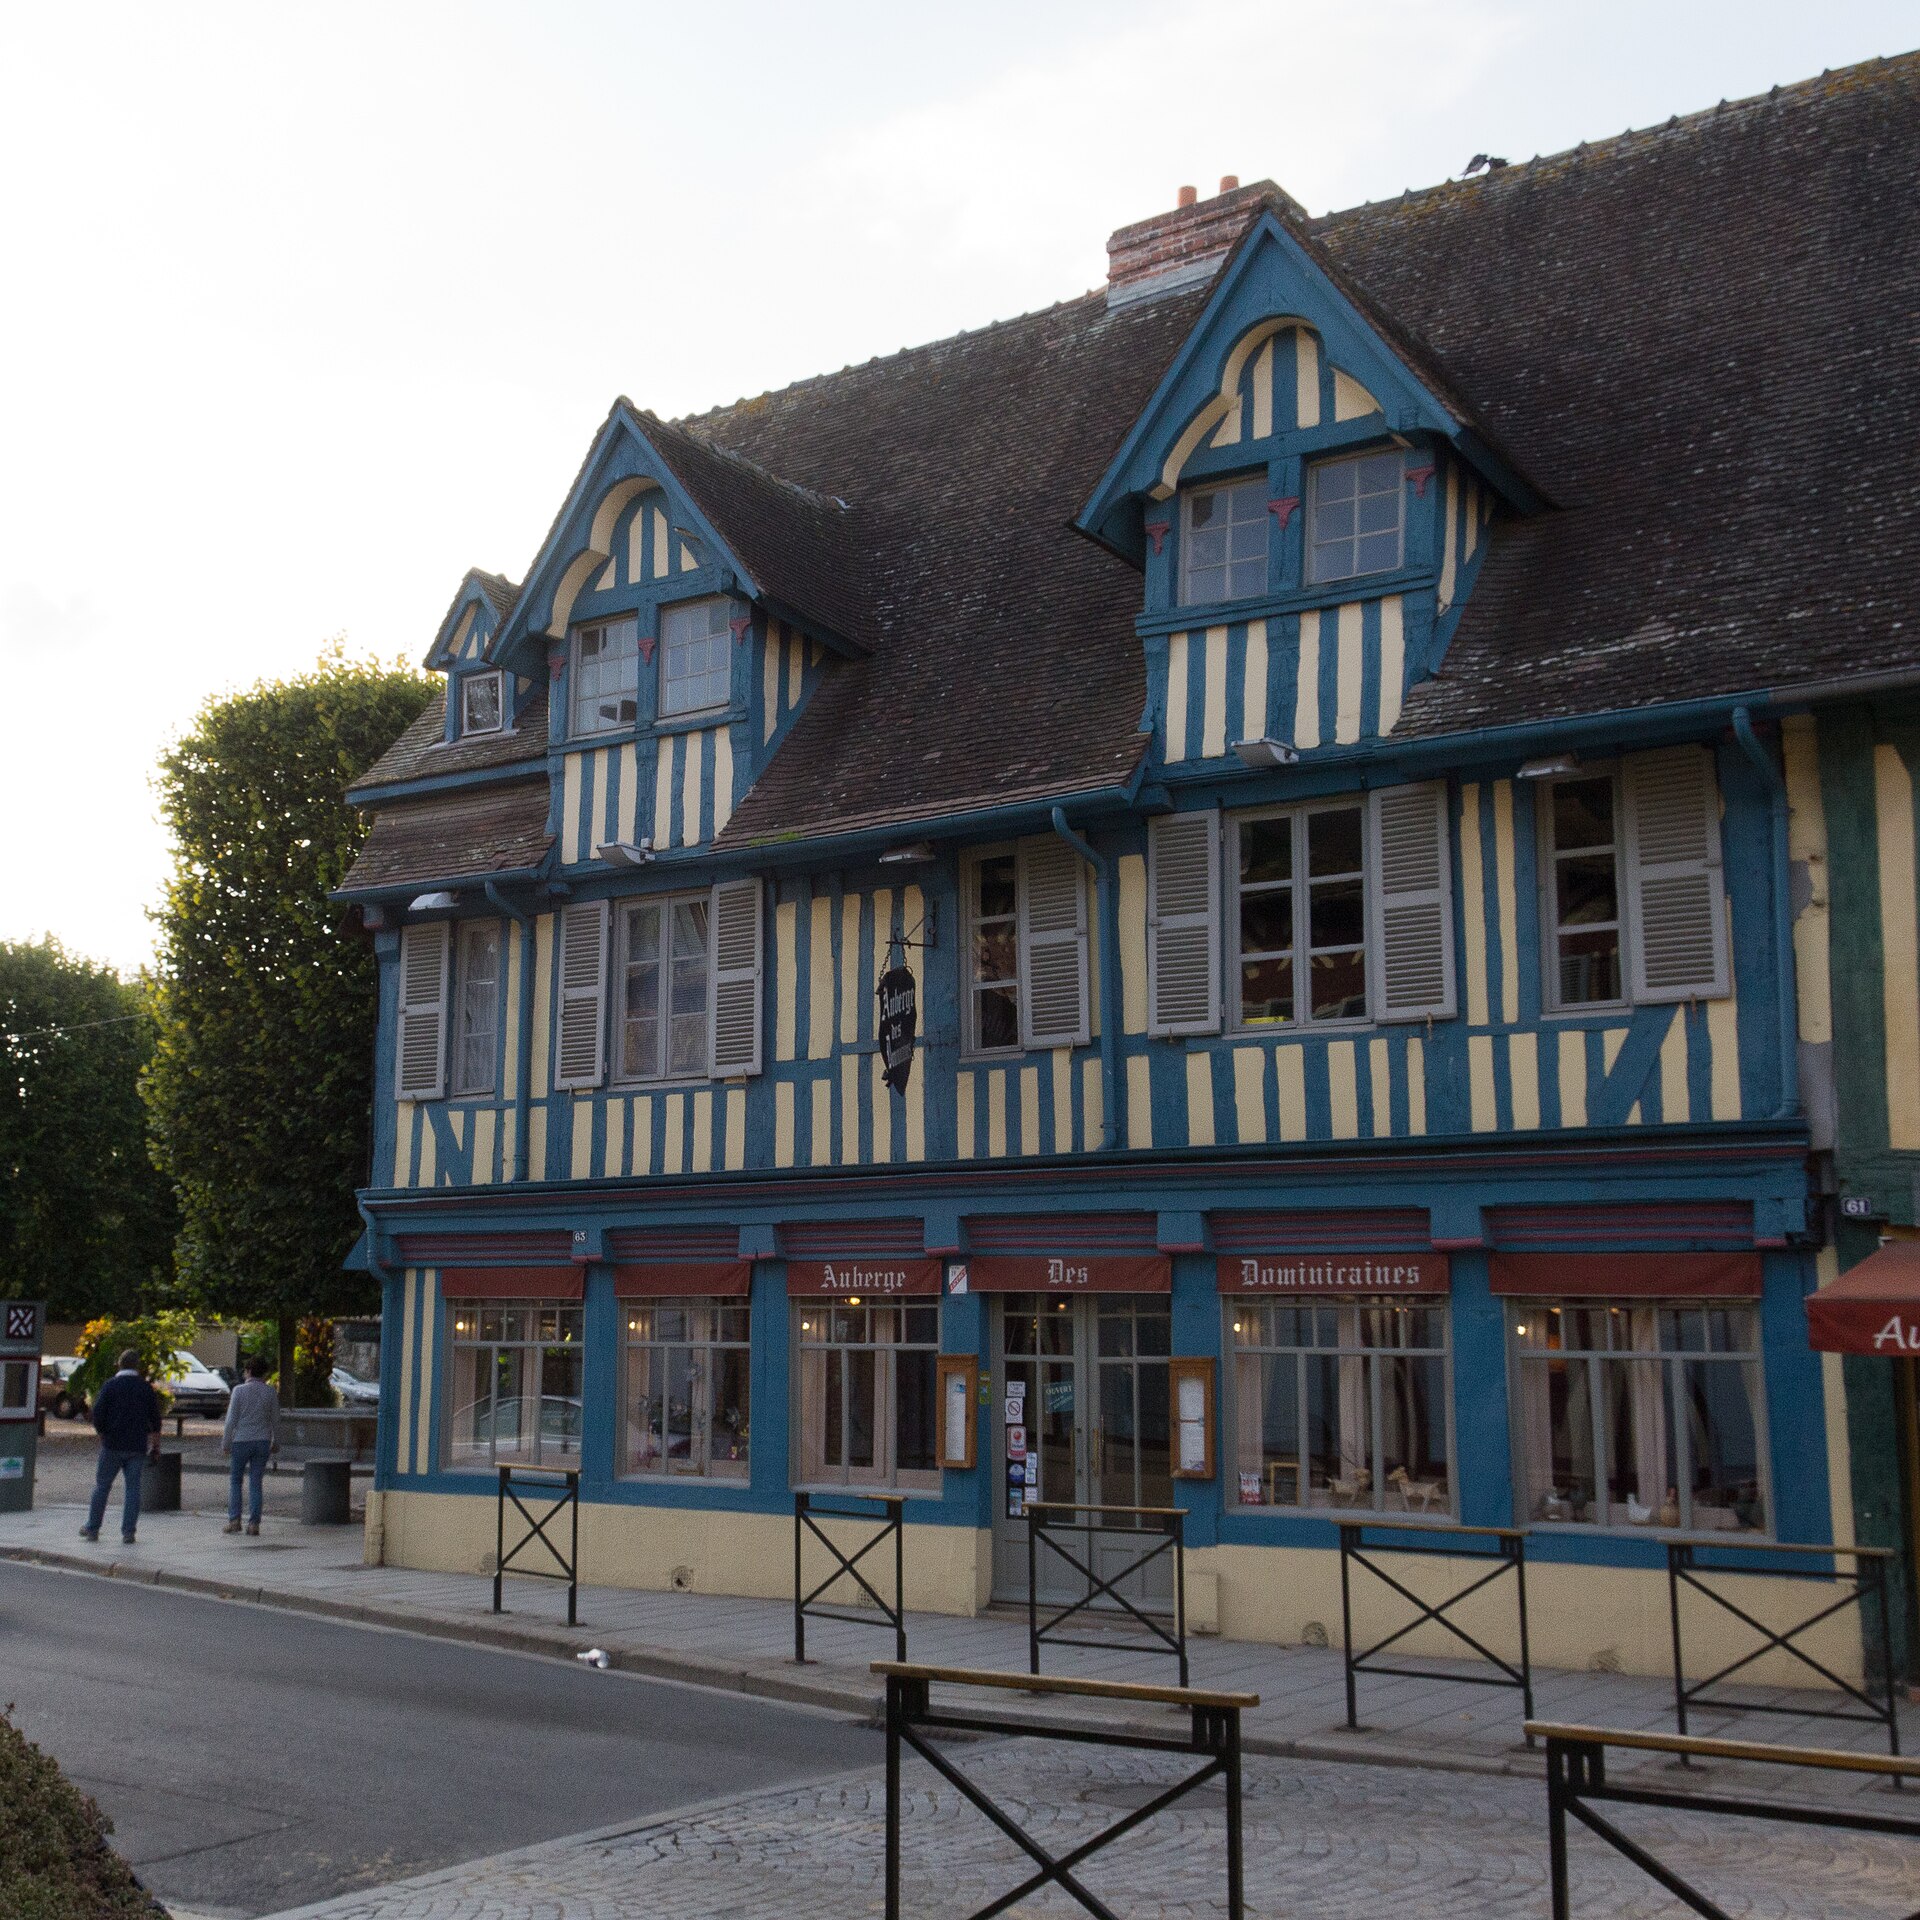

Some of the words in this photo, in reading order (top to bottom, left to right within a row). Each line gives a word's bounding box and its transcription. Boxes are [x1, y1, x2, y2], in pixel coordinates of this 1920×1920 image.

[882, 987, 914, 1021] Auberge
[1847, 1200, 1865, 1213] 61
[821, 1264, 906, 1293] Auberge
[1048, 1259, 1088, 1284] Des
[1241, 1259, 1420, 1286] Dominicaines
